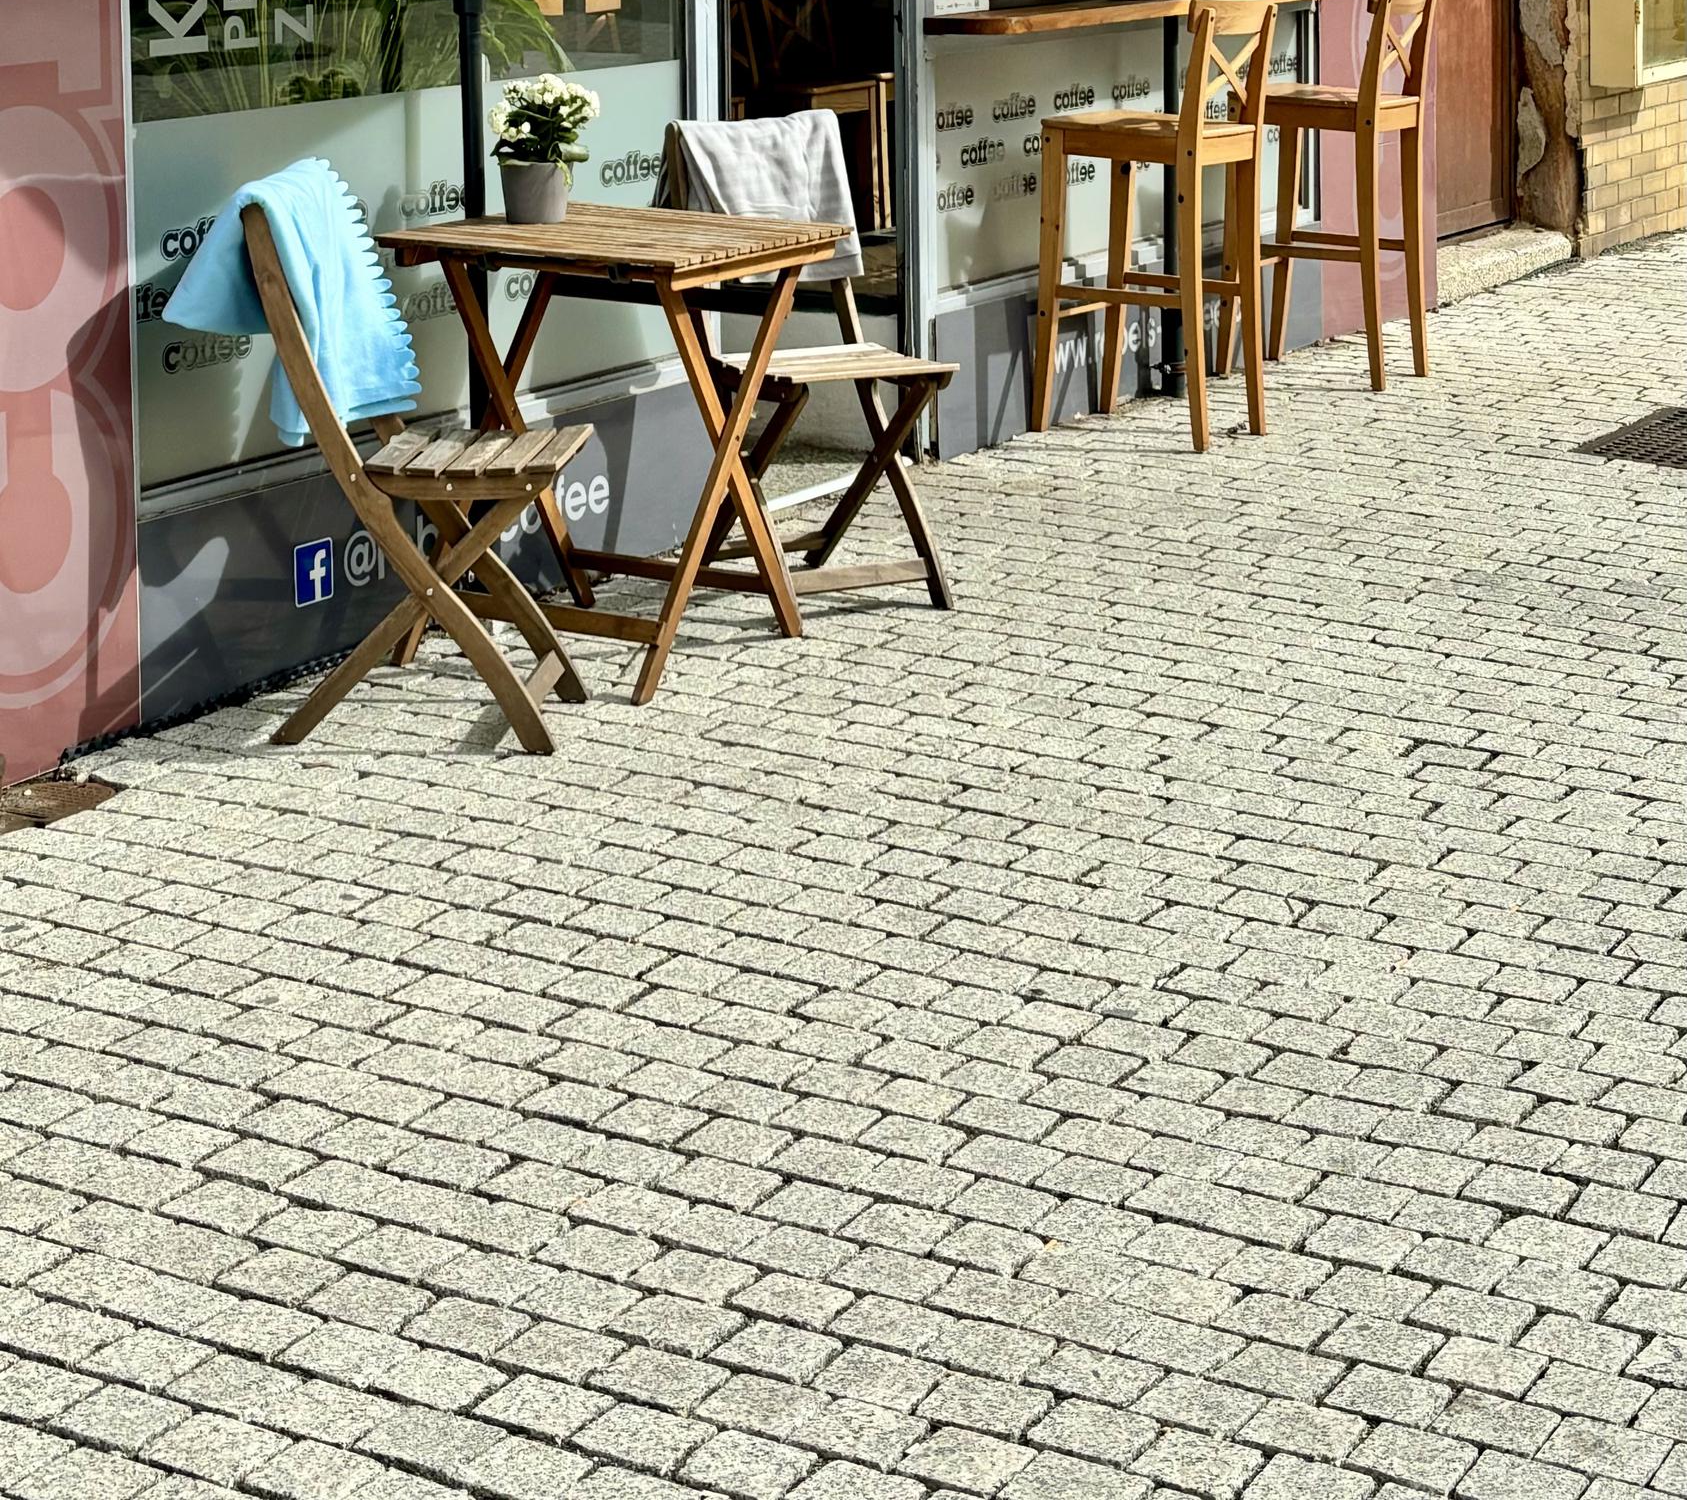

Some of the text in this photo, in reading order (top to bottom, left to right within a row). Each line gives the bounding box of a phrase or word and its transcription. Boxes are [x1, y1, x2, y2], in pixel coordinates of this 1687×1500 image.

[274, 3, 315, 46] Z
[1053, 83, 1096, 112] coffee
[1111, 75, 1151, 101] coffee
[936, 103, 975, 132] offee
[992, 92, 1037, 122] coffee
[1203, 99, 1227, 120] ffee
[960, 136, 1006, 168] coffee
[399, 180, 466, 220] coffe
[936, 182, 975, 213] offee
